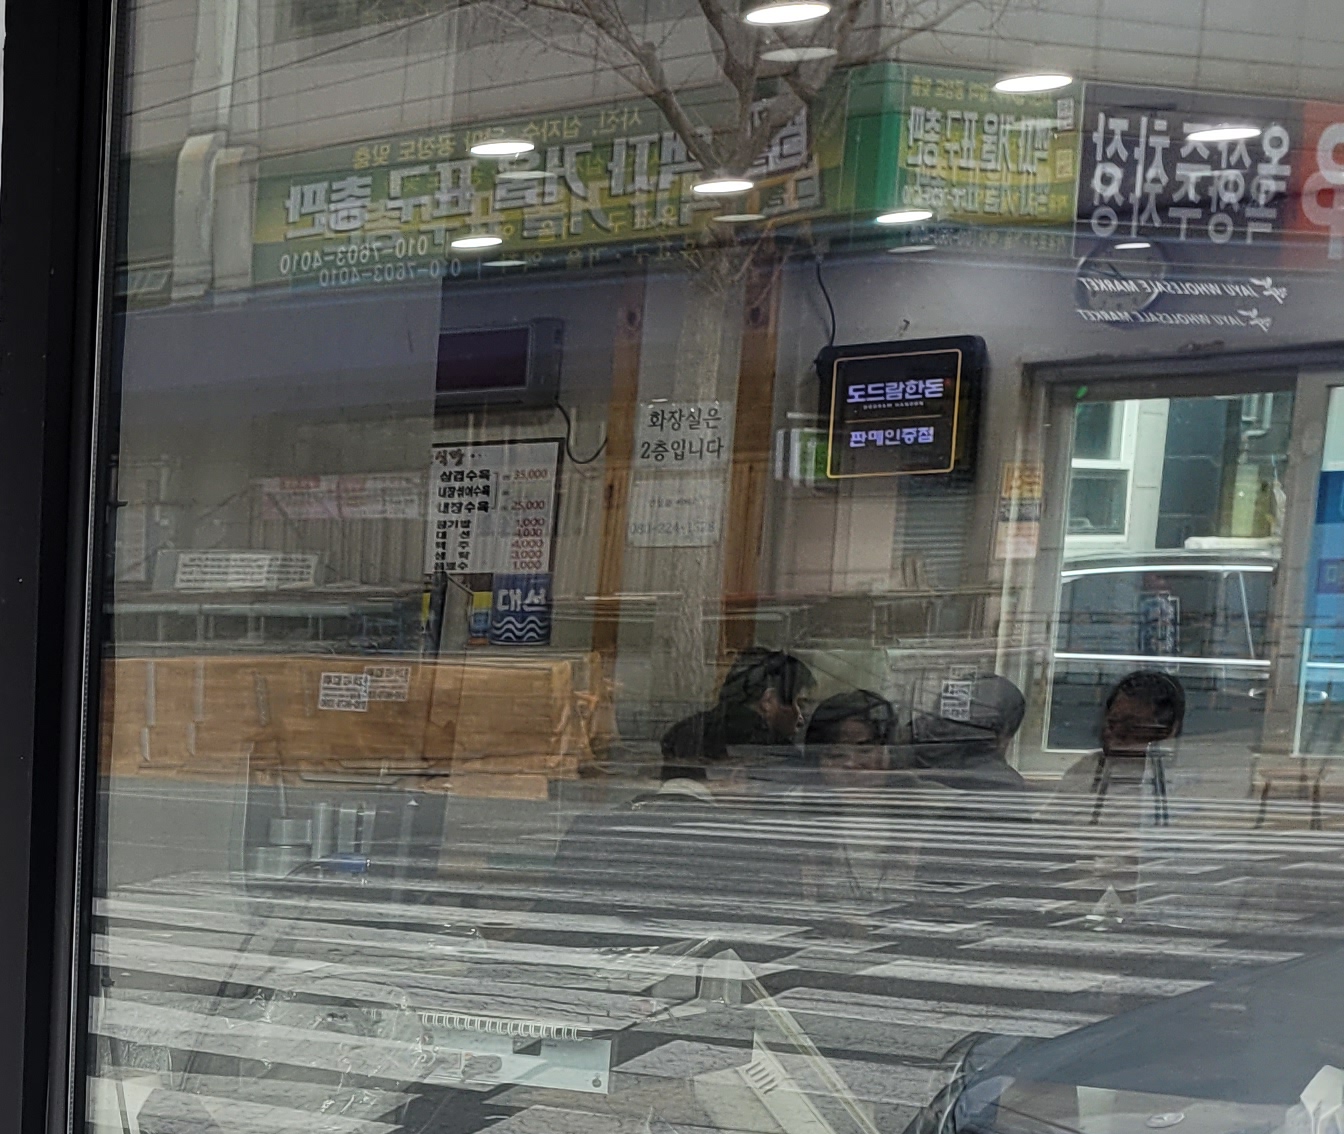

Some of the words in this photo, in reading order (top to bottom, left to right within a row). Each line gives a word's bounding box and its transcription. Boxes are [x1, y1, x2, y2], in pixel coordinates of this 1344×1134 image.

[846, 378, 945, 404] 도드람한돈
[647, 405, 723, 432] 화장실은
[640, 437, 725, 462] 2층입니다
[849, 426, 935, 448] 판매인증점
[496, 587, 547, 613] 대선
